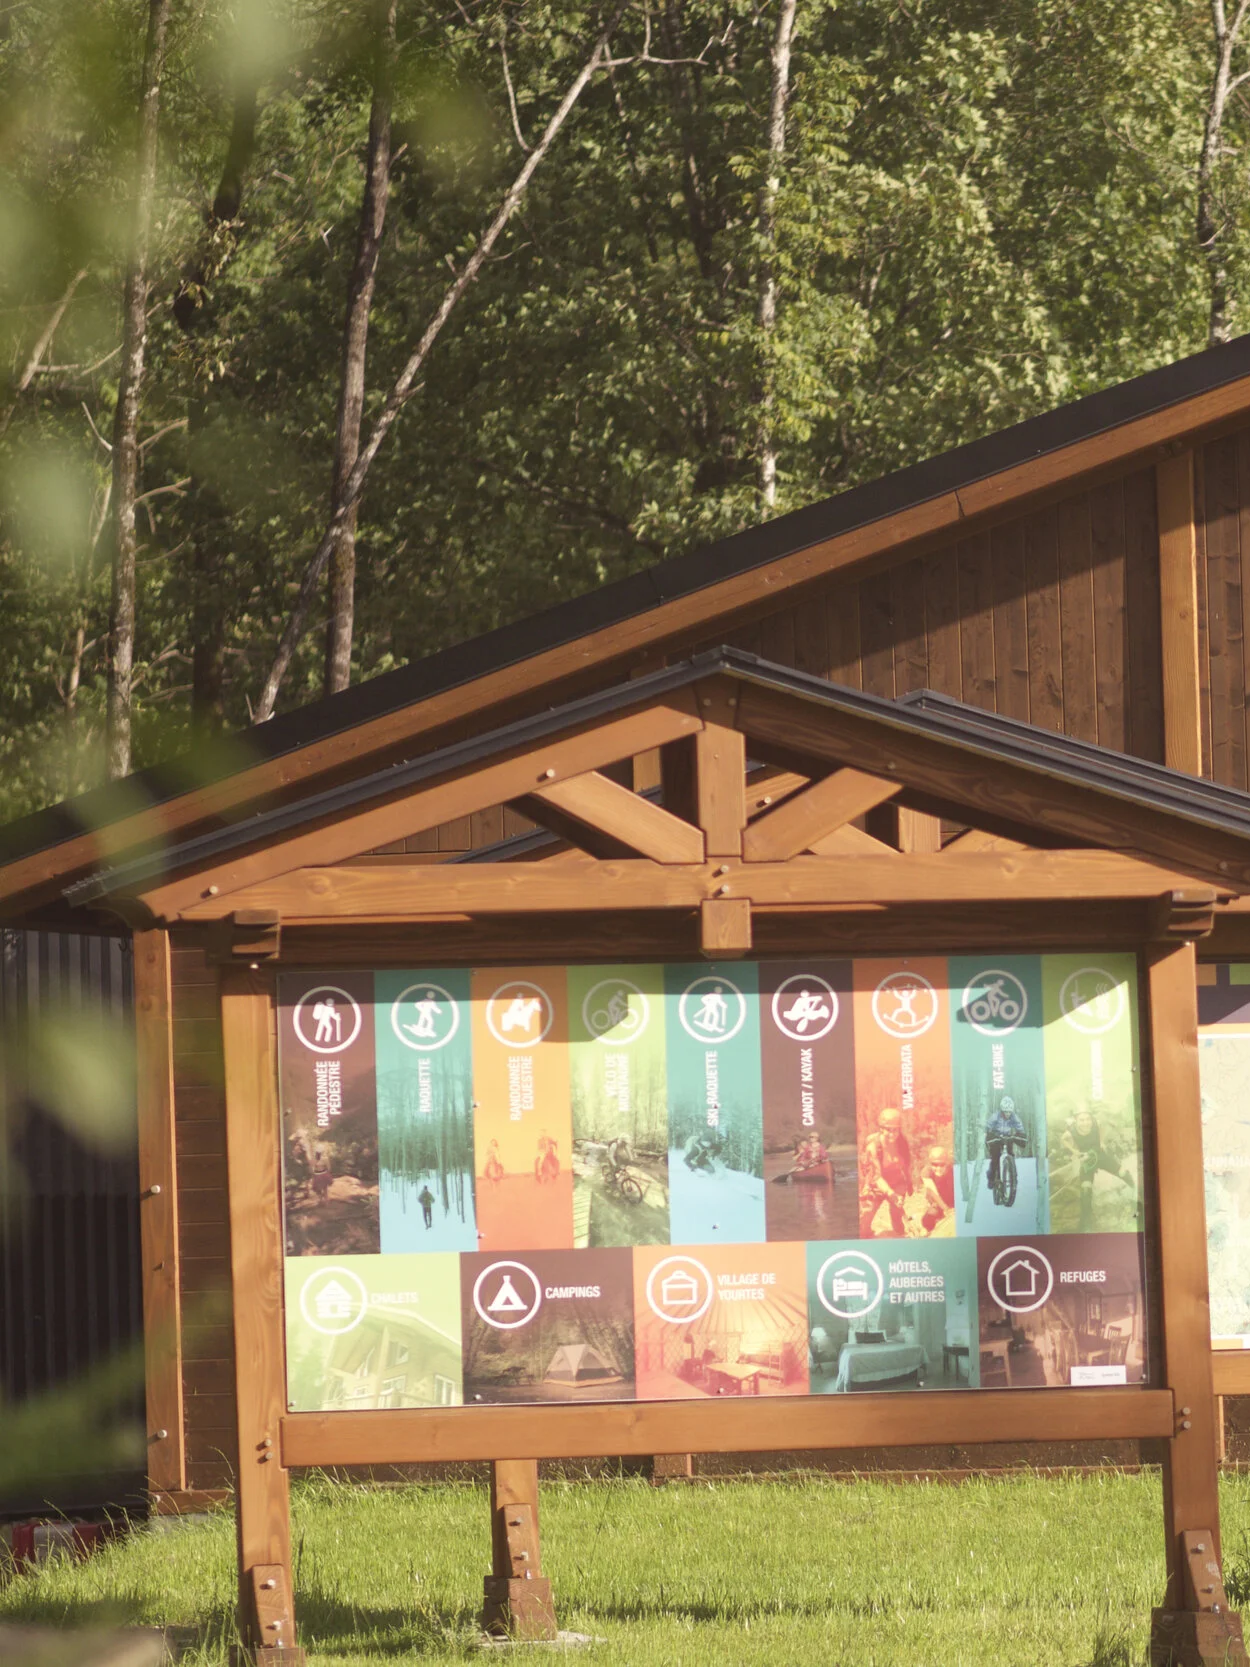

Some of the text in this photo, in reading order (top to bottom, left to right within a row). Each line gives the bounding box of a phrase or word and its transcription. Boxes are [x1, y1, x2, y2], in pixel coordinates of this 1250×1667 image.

[801, 1048, 813, 1082] KAYAK
[902, 1044, 914, 1110] VIA-FERRATA
[993, 1043, 1005, 1090] FAT-BIKE
[315, 1061, 329, 1127] RANDONNÉE
[328, 1061, 341, 1115] PÉDESTRE
[418, 1058, 432, 1113] RAQUETTE
[508, 1056, 521, 1120] RANDONNÉE
[706, 1051, 719, 1127] SKI-RAQUETTE
[802, 1093, 814, 1127] CANOT
[717, 1273, 776, 1287] VILLAGE DE
[889, 1259, 931, 1275] HÔTELS,
[889, 1275, 944, 1289] AUBERGES
[1059, 1270, 1106, 1284] REFUGES
[545, 1285, 601, 1299] CAMPINGS
[717, 1288, 765, 1301] YOURTES
[889, 1290, 945, 1304] ET AUTRES
